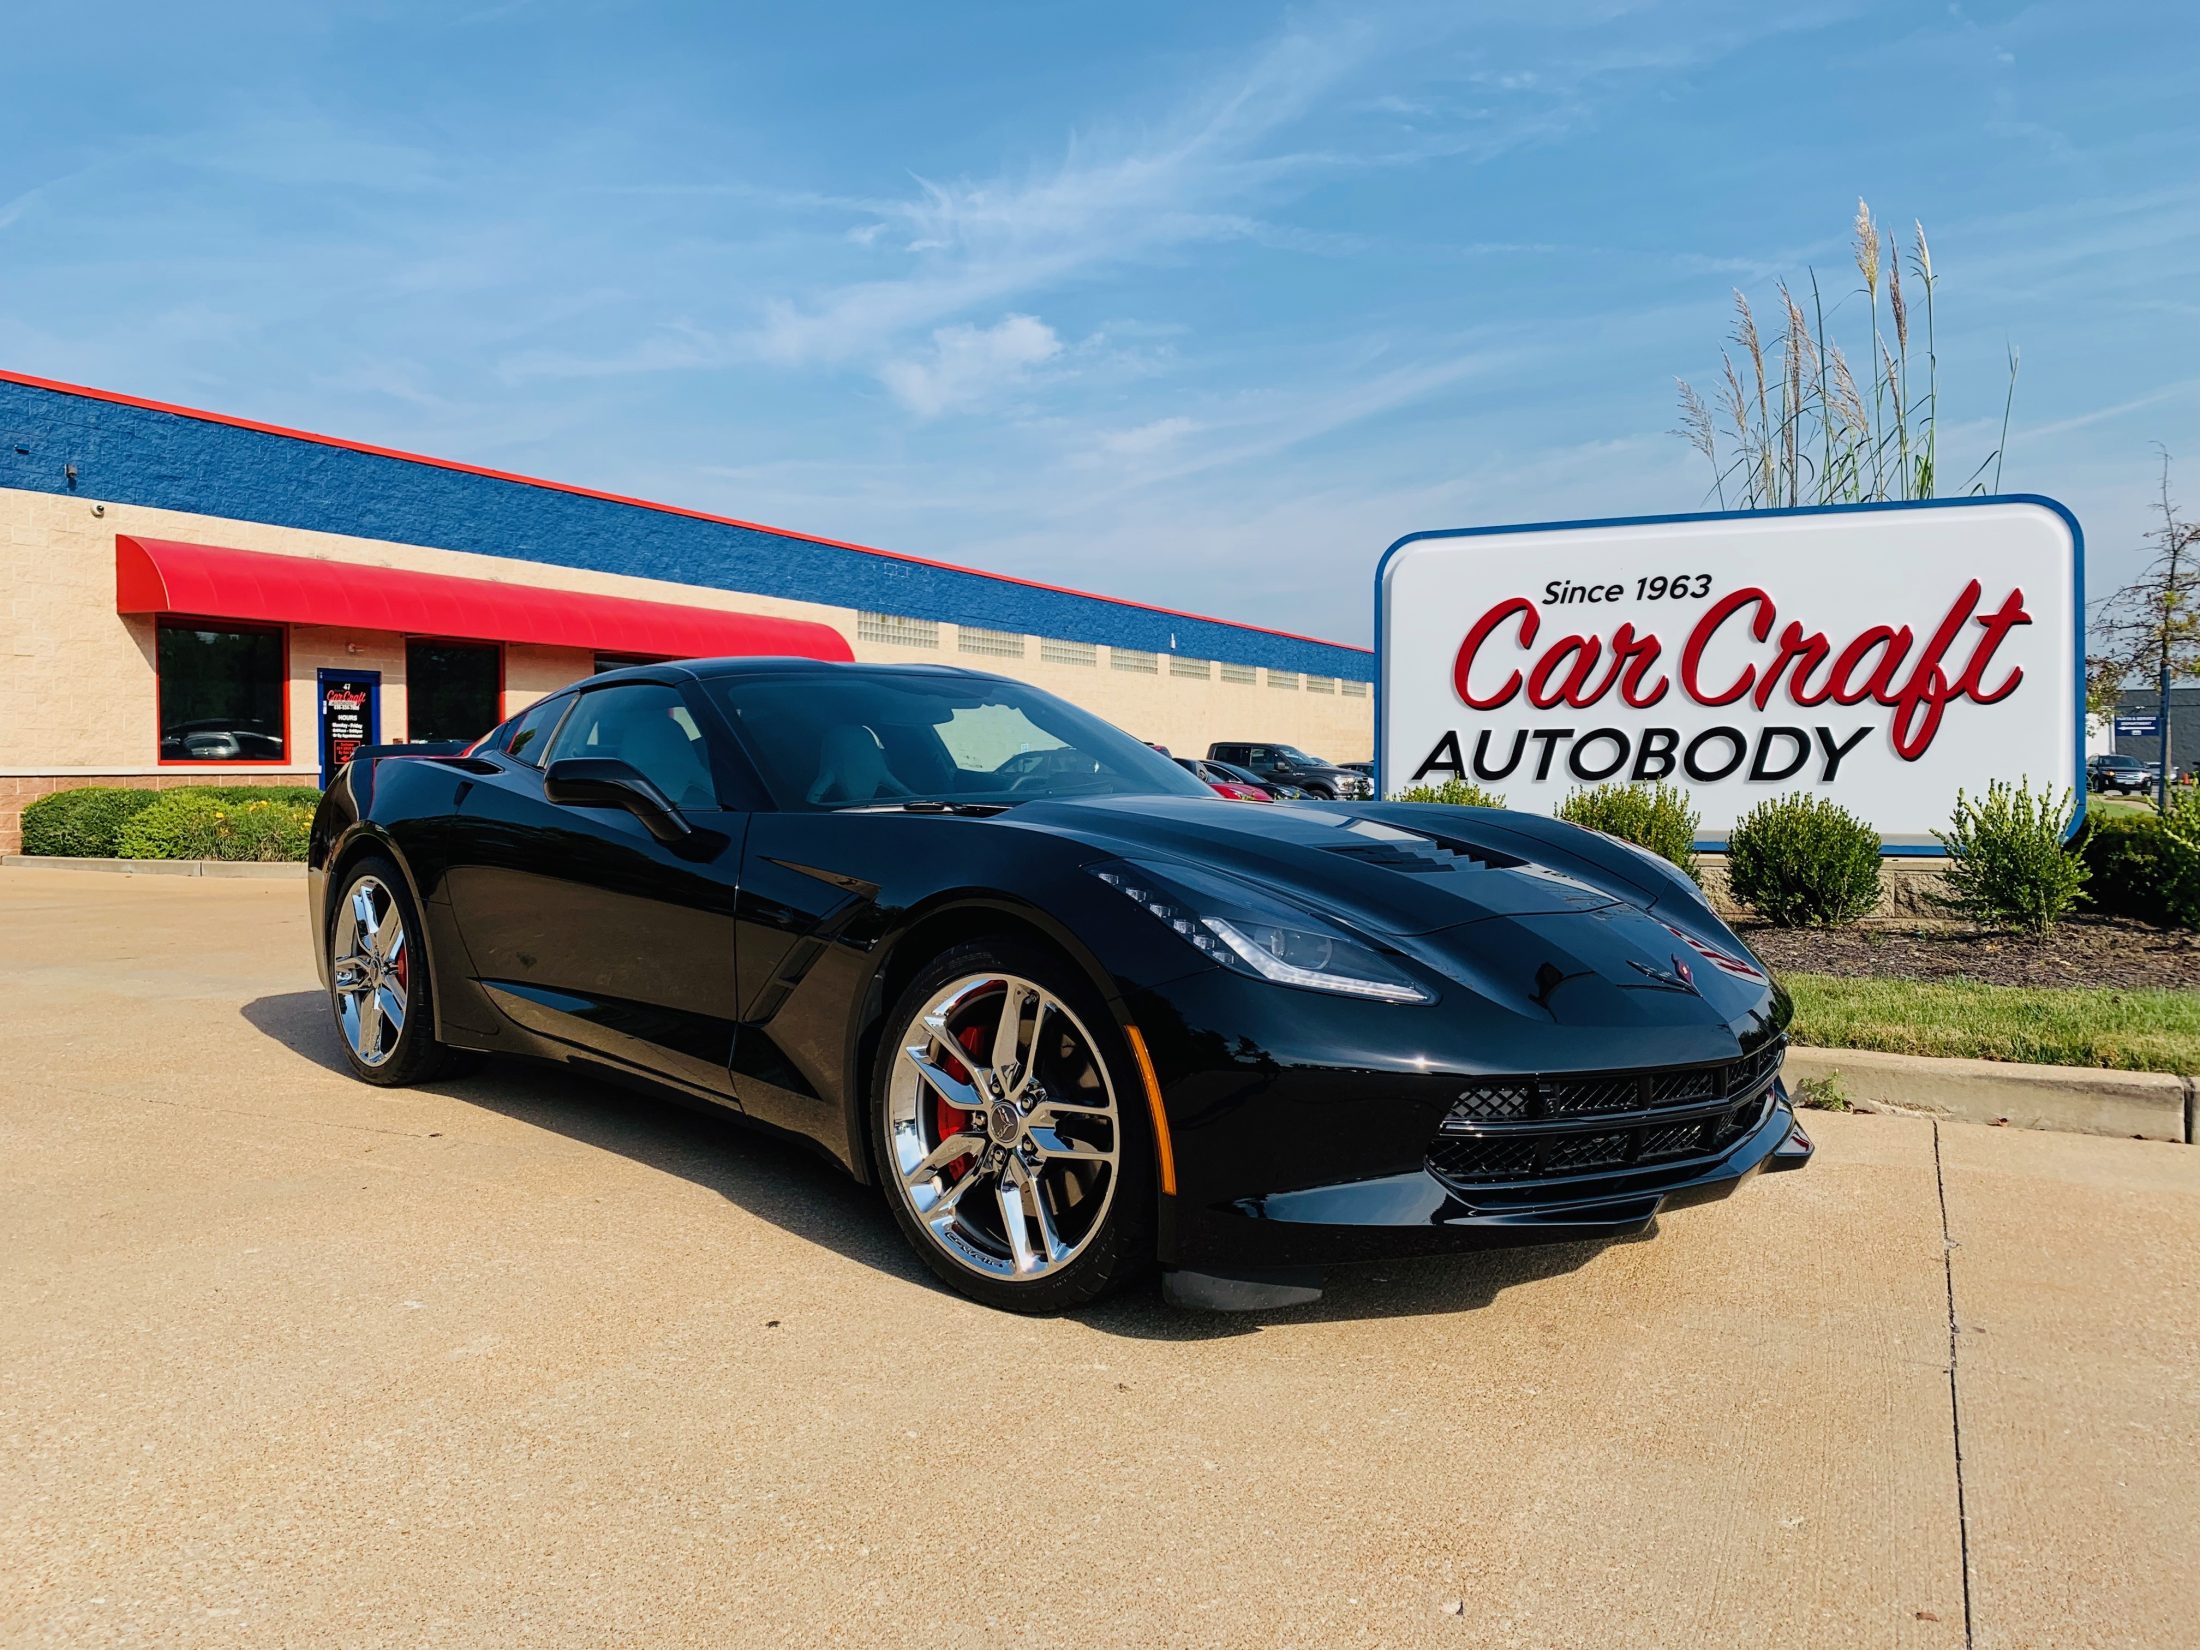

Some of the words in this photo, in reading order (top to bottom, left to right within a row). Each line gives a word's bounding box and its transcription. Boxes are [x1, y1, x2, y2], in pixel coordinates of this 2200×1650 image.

[1542, 579, 1624, 605] Since
[1636, 573, 1712, 601] 1963
[1454, 597, 1668, 711] Car
[1681, 579, 2033, 762] Craft
[327, 690, 343, 702] Car
[344, 690, 366, 705] Craft
[1411, 726, 1875, 783] AUTOBODY
